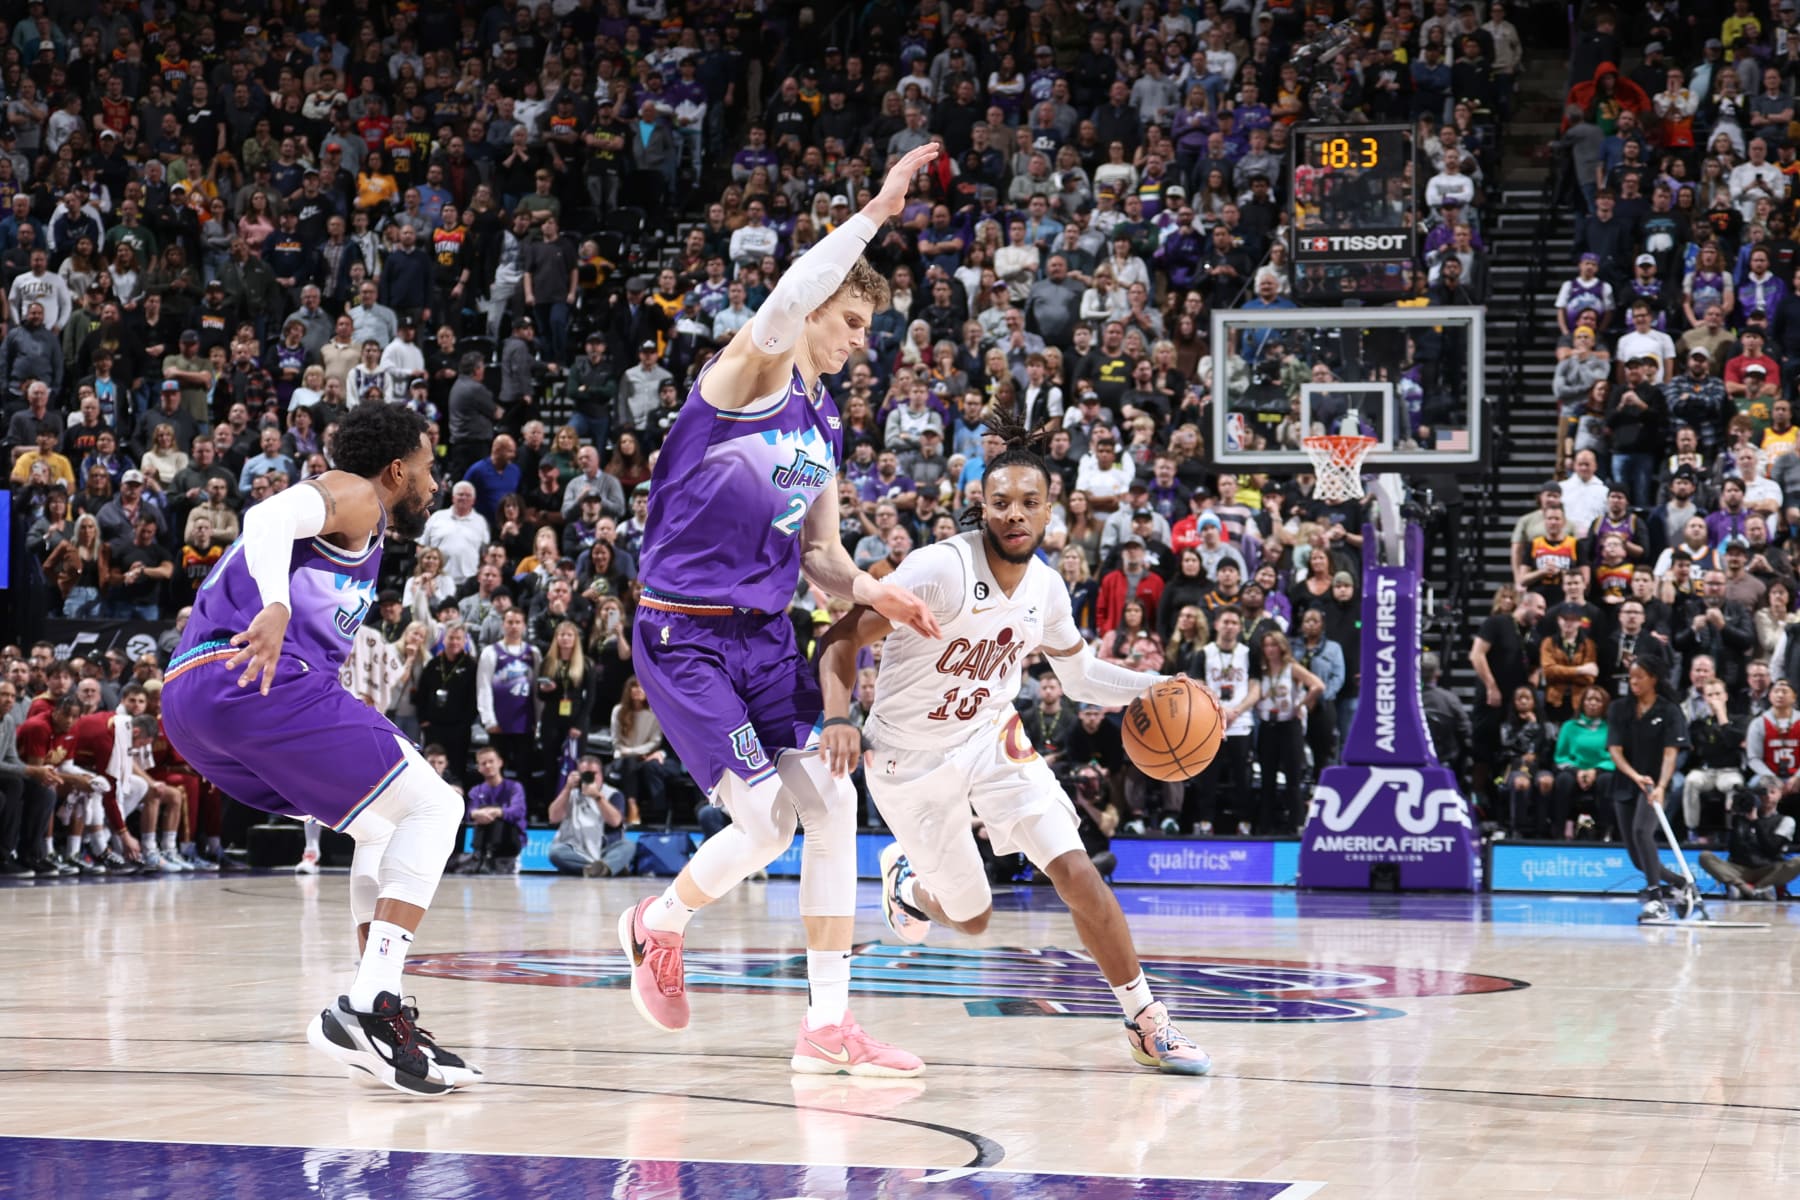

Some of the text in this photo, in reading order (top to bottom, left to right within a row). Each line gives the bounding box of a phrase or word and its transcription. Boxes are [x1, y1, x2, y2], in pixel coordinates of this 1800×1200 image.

[1320, 137, 1379, 168] 18.3
[434, 240, 461, 254] UTAH
[1328, 234, 1408, 251] TISSOT
[23, 282, 53, 297] UTAH
[771, 493, 807, 536] 2
[975, 583, 986, 599] 6
[1375, 576, 1397, 753] AMERICA FIRST
[1312, 836, 1457, 853] AMERICA FIRST
[1345, 853, 1424, 863] CREDIT UNION
